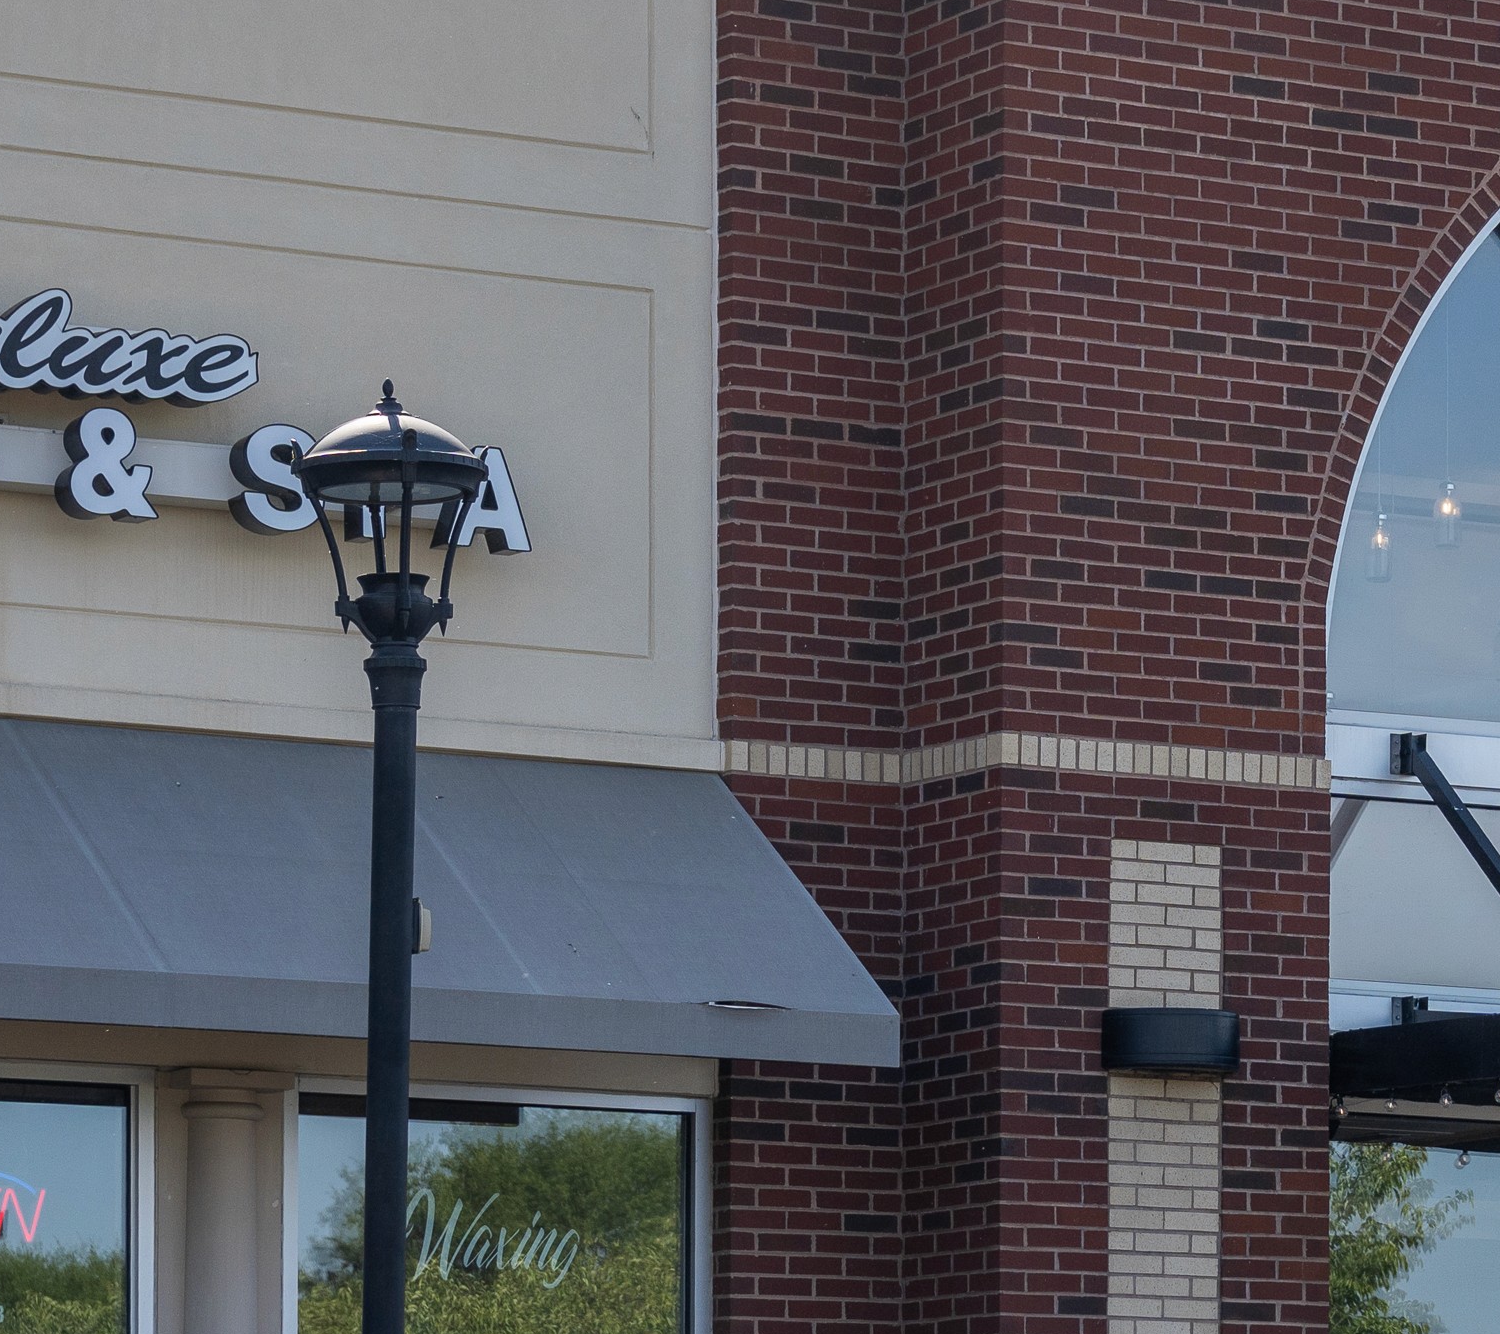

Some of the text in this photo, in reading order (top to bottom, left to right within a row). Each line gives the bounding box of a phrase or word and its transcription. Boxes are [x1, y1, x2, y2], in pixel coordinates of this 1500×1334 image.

[55, 406, 159, 521] &
[229, 423, 532, 555] SA
[403, 1190, 581, 1289] Waxing
